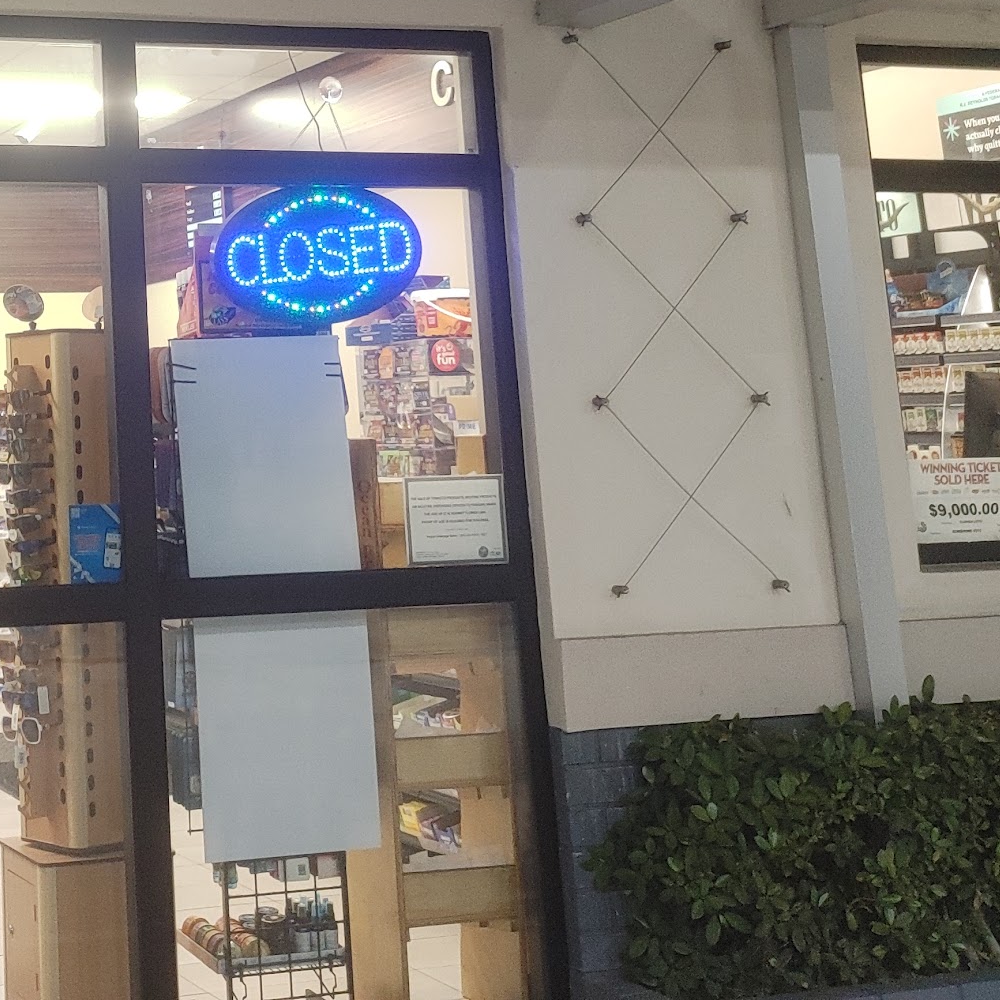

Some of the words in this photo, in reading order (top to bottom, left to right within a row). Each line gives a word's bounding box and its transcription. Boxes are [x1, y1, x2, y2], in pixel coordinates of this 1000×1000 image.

[963, 117, 986, 129] When
[965, 126, 994, 141] actually
[967, 143, 983, 153] why
[227, 221, 411, 286] CLOSED
[436, 352, 456, 366] fun
[920, 463, 966, 474] WINNING
[934, 474, 962, 485] SOLD
[964, 474, 990, 485] HERE
[929, 503, 999, 519] $9,000.00
